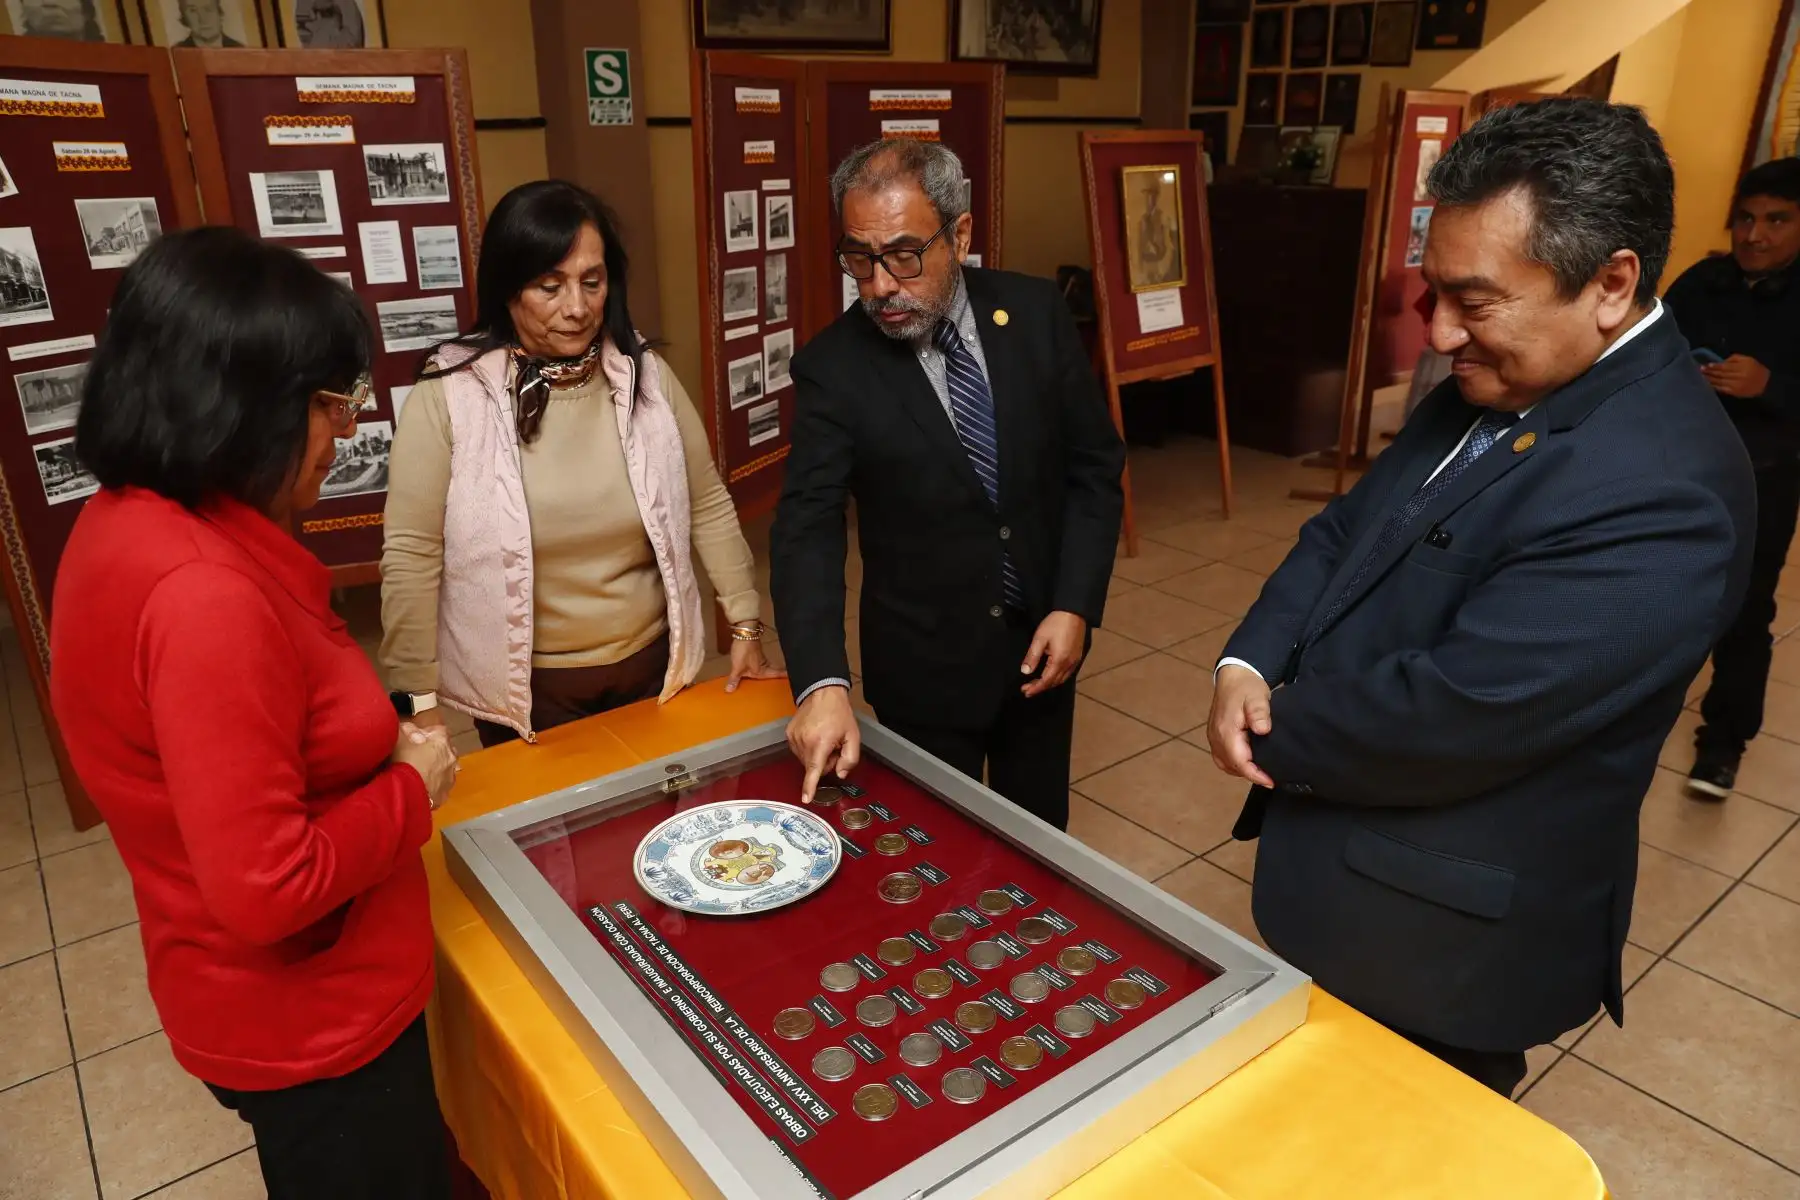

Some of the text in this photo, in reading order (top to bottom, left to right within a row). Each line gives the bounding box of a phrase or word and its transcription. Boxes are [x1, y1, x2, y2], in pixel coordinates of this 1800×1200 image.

[21, 89, 46, 97] MAGNA
[60, 90, 82, 98] TACNA
[593, 53, 623, 95] S
[590, 906, 807, 1138] OBRAS EJECUTADAS POR SU GOBIERNO E INAUGURADAS CON OCASIÓN
[614, 902, 829, 1120] DEL XXV ANIVERSARIO DE LA REINCORPORACIÓN DE TACNA AL PERÚ
